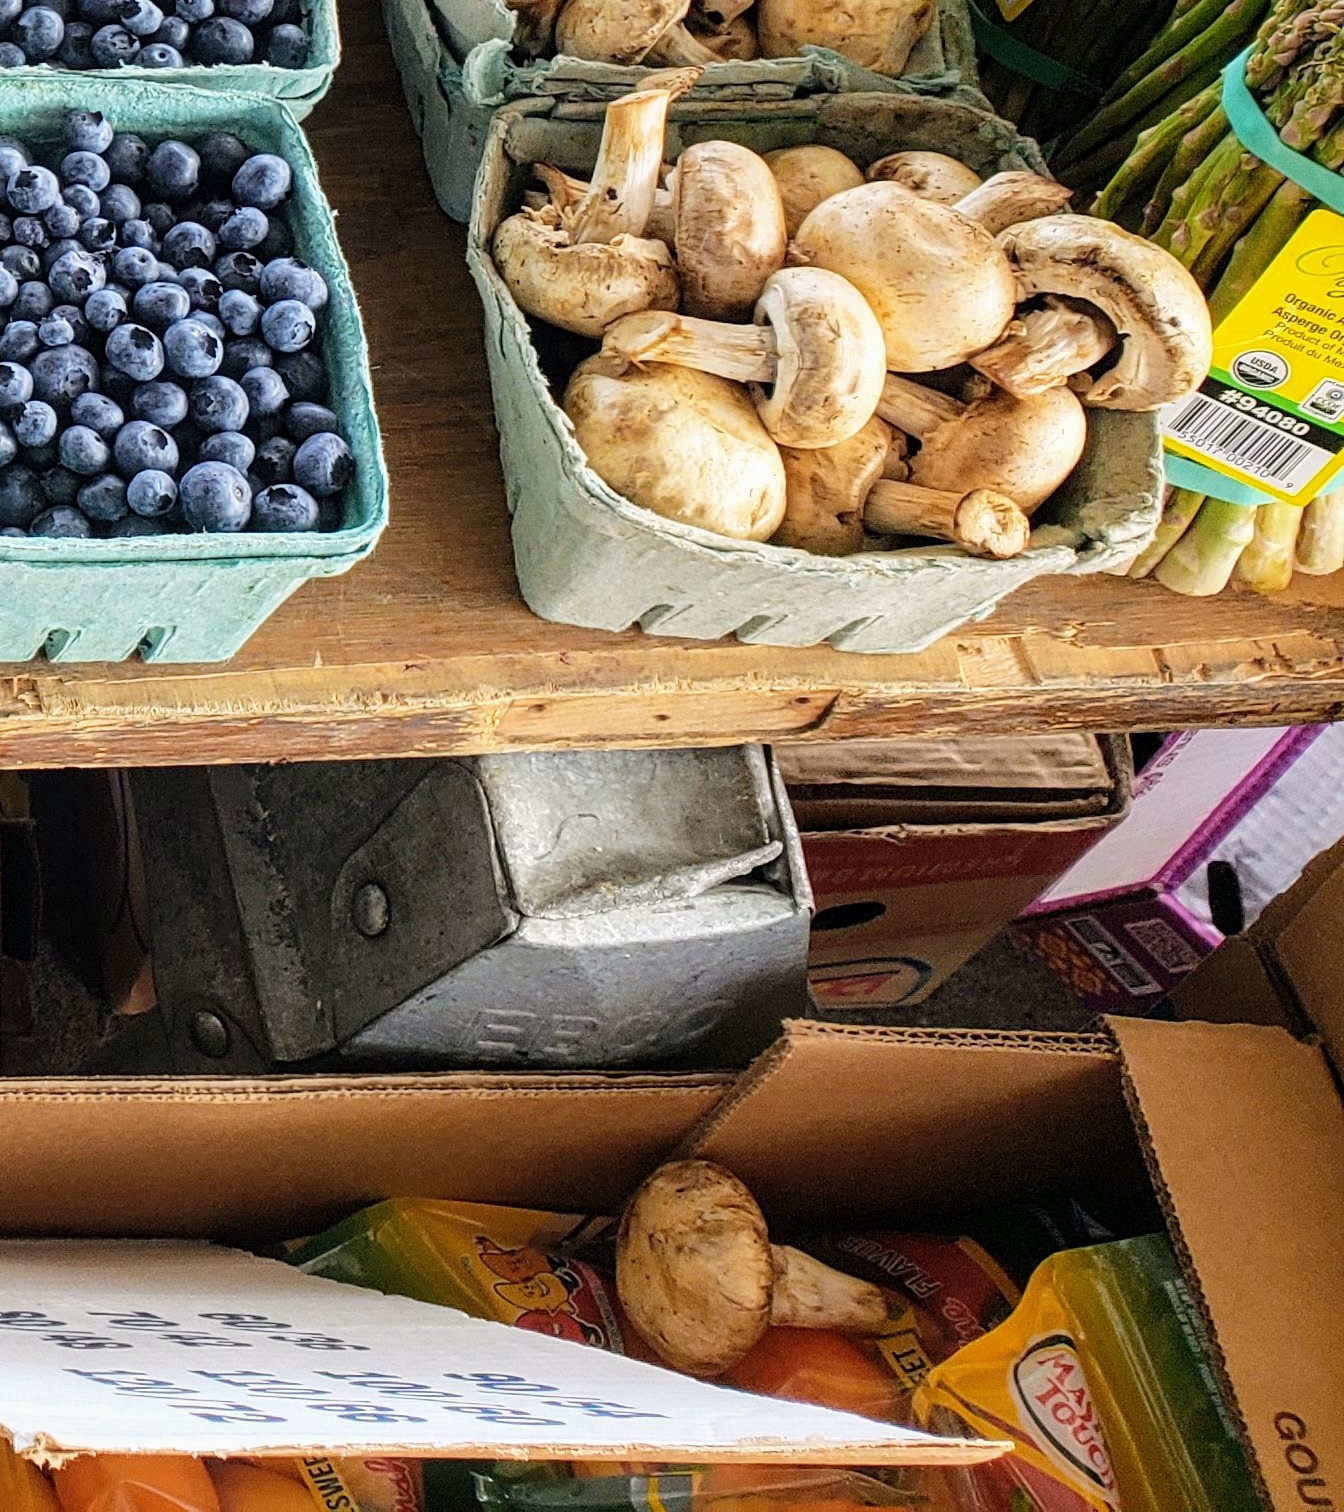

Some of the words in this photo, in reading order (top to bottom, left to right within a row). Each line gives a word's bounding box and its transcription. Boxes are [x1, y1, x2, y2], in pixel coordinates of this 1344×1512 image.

[1272, 307, 1327, 336] Asperge
[1284, 293, 1337, 322] Organic
[1263, 329, 1305, 352] Produit
[1307, 348, 1322, 359] du
[1274, 322, 1320, 346] Product
[1321, 341, 1333, 352] of
[1250, 356, 1278, 374] USDA
[1219, 388, 1311, 437] #94080
[1178, 429, 1223, 455] 55017
[1226, 450, 1272, 479] 00210
[86, 1309, 254, 1348] 70/42
[198, 1311, 372, 1352] 60/36
[60, 1367, 289, 1424] 120/72
[187, 1368, 428, 1424] 110/66
[312, 1369, 567, 1425] 100/60
[1273, 1412, 1338, 1512] GOU
